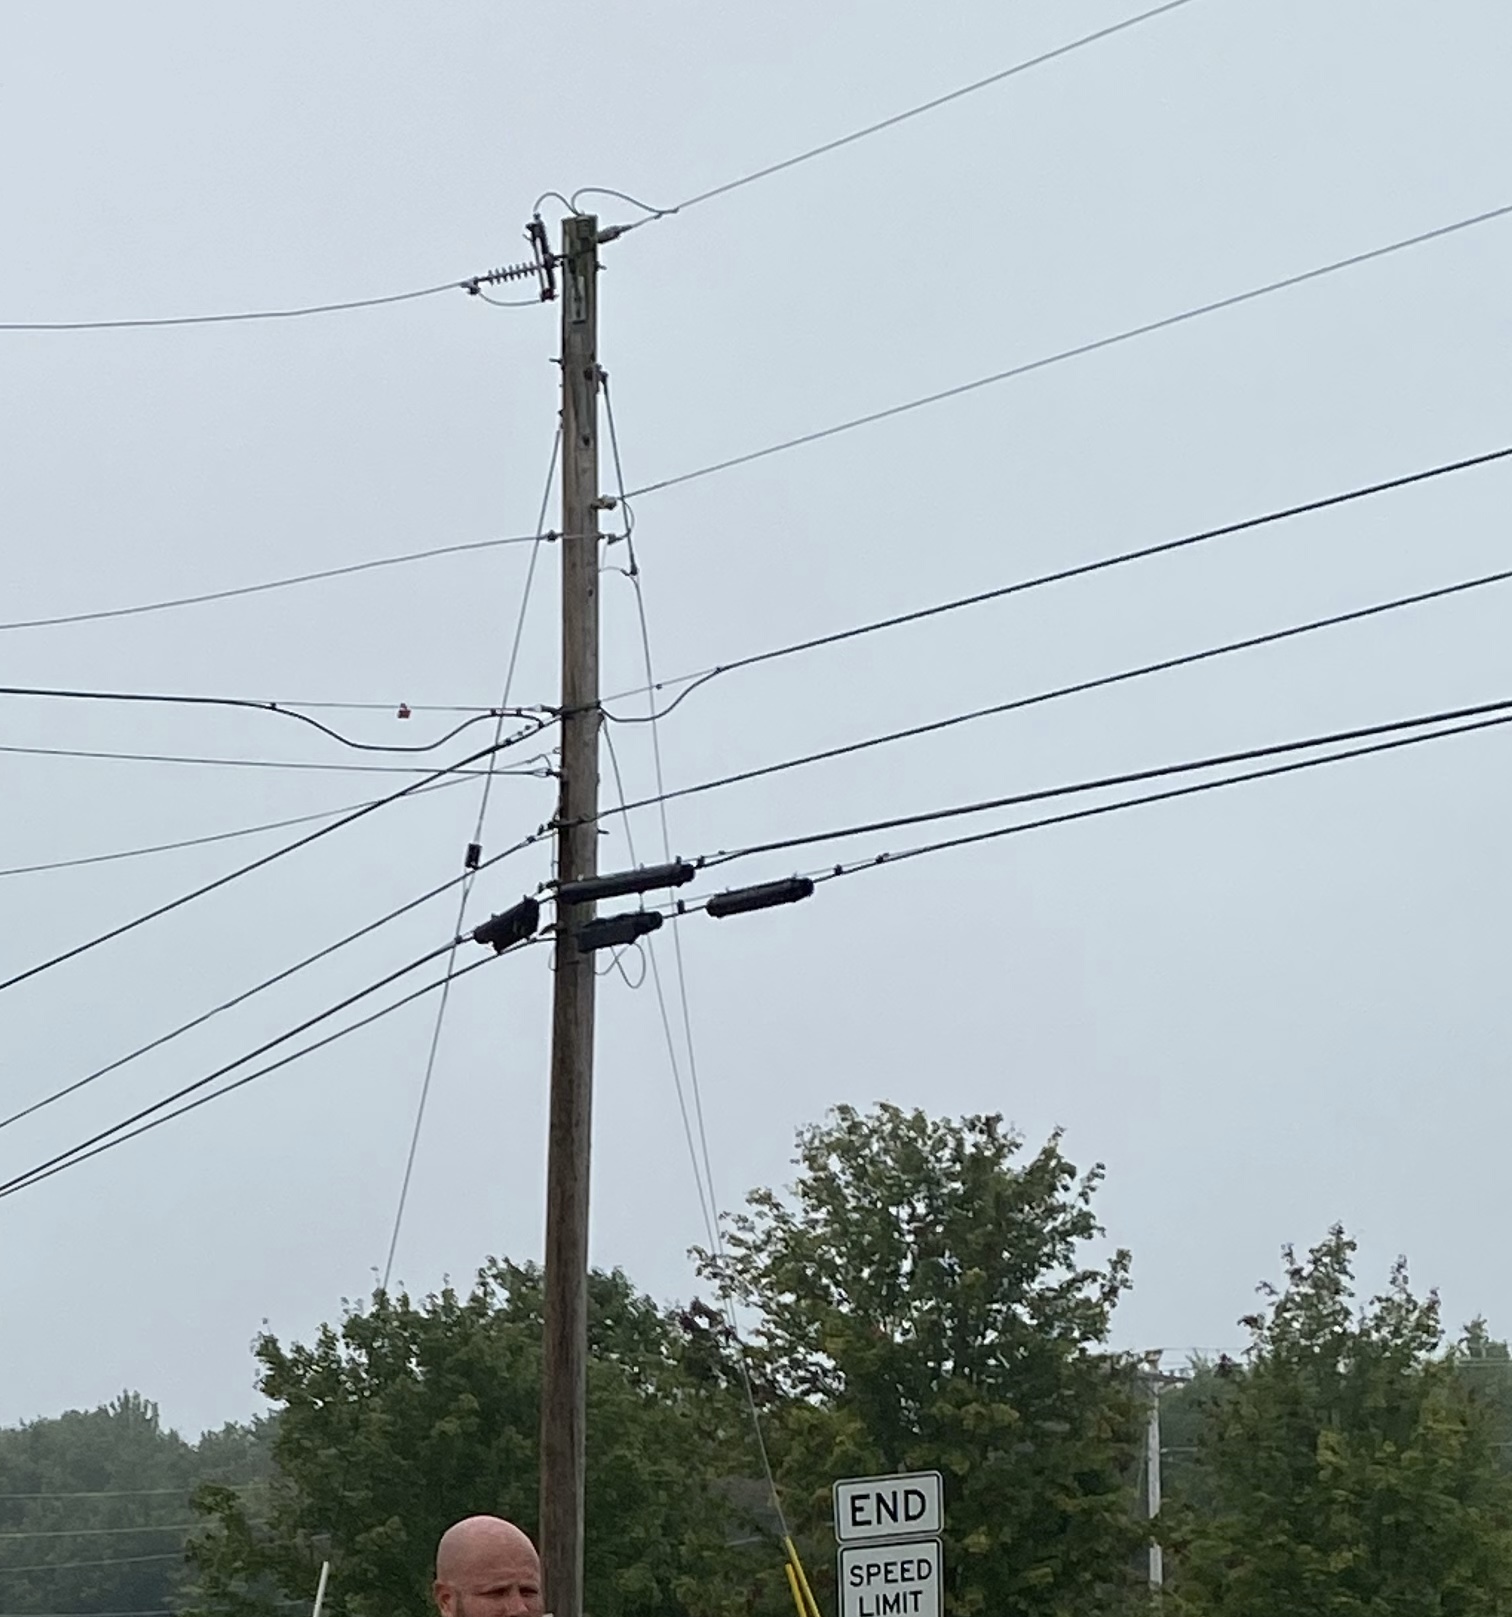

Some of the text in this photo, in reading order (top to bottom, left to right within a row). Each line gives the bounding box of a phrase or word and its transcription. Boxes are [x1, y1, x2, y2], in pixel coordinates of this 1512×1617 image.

[850, 1489, 926, 1526] END
[849, 1558, 932, 1587] SPEED
[859, 1590, 923, 1617] LIMIT
